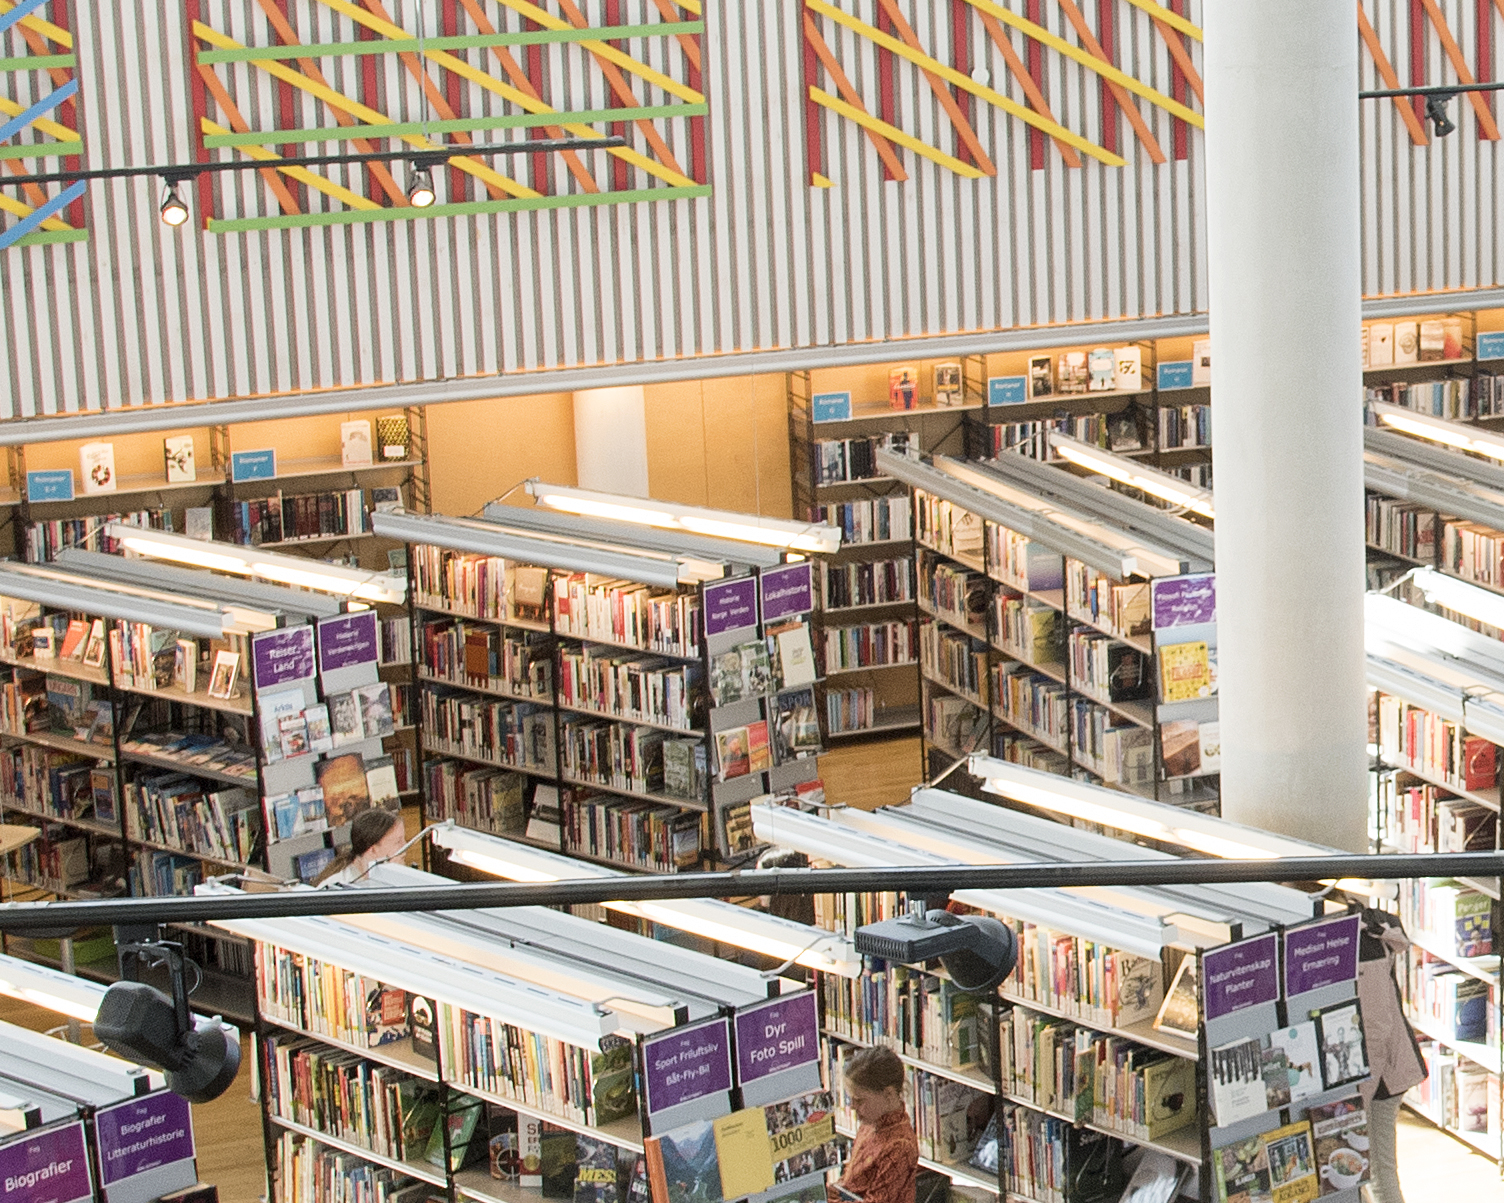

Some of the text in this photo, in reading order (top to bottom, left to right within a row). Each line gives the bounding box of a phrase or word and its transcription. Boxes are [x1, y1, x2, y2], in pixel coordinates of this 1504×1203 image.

[1209, 957, 1271, 984] Naturvitenskap
[1224, 977, 1256, 996] Planter
[765, 1021, 787, 1040] Dyr
[750, 1034, 806, 1065] Foto Spill
[655, 1053, 679, 1073] Sport
[120, 1114, 166, 1137] Biografier
[106, 1128, 186, 1162] Litteraturhistorie
[773, 1127, 804, 1153] 1000
[4, 1159, 73, 1193] Biografier
